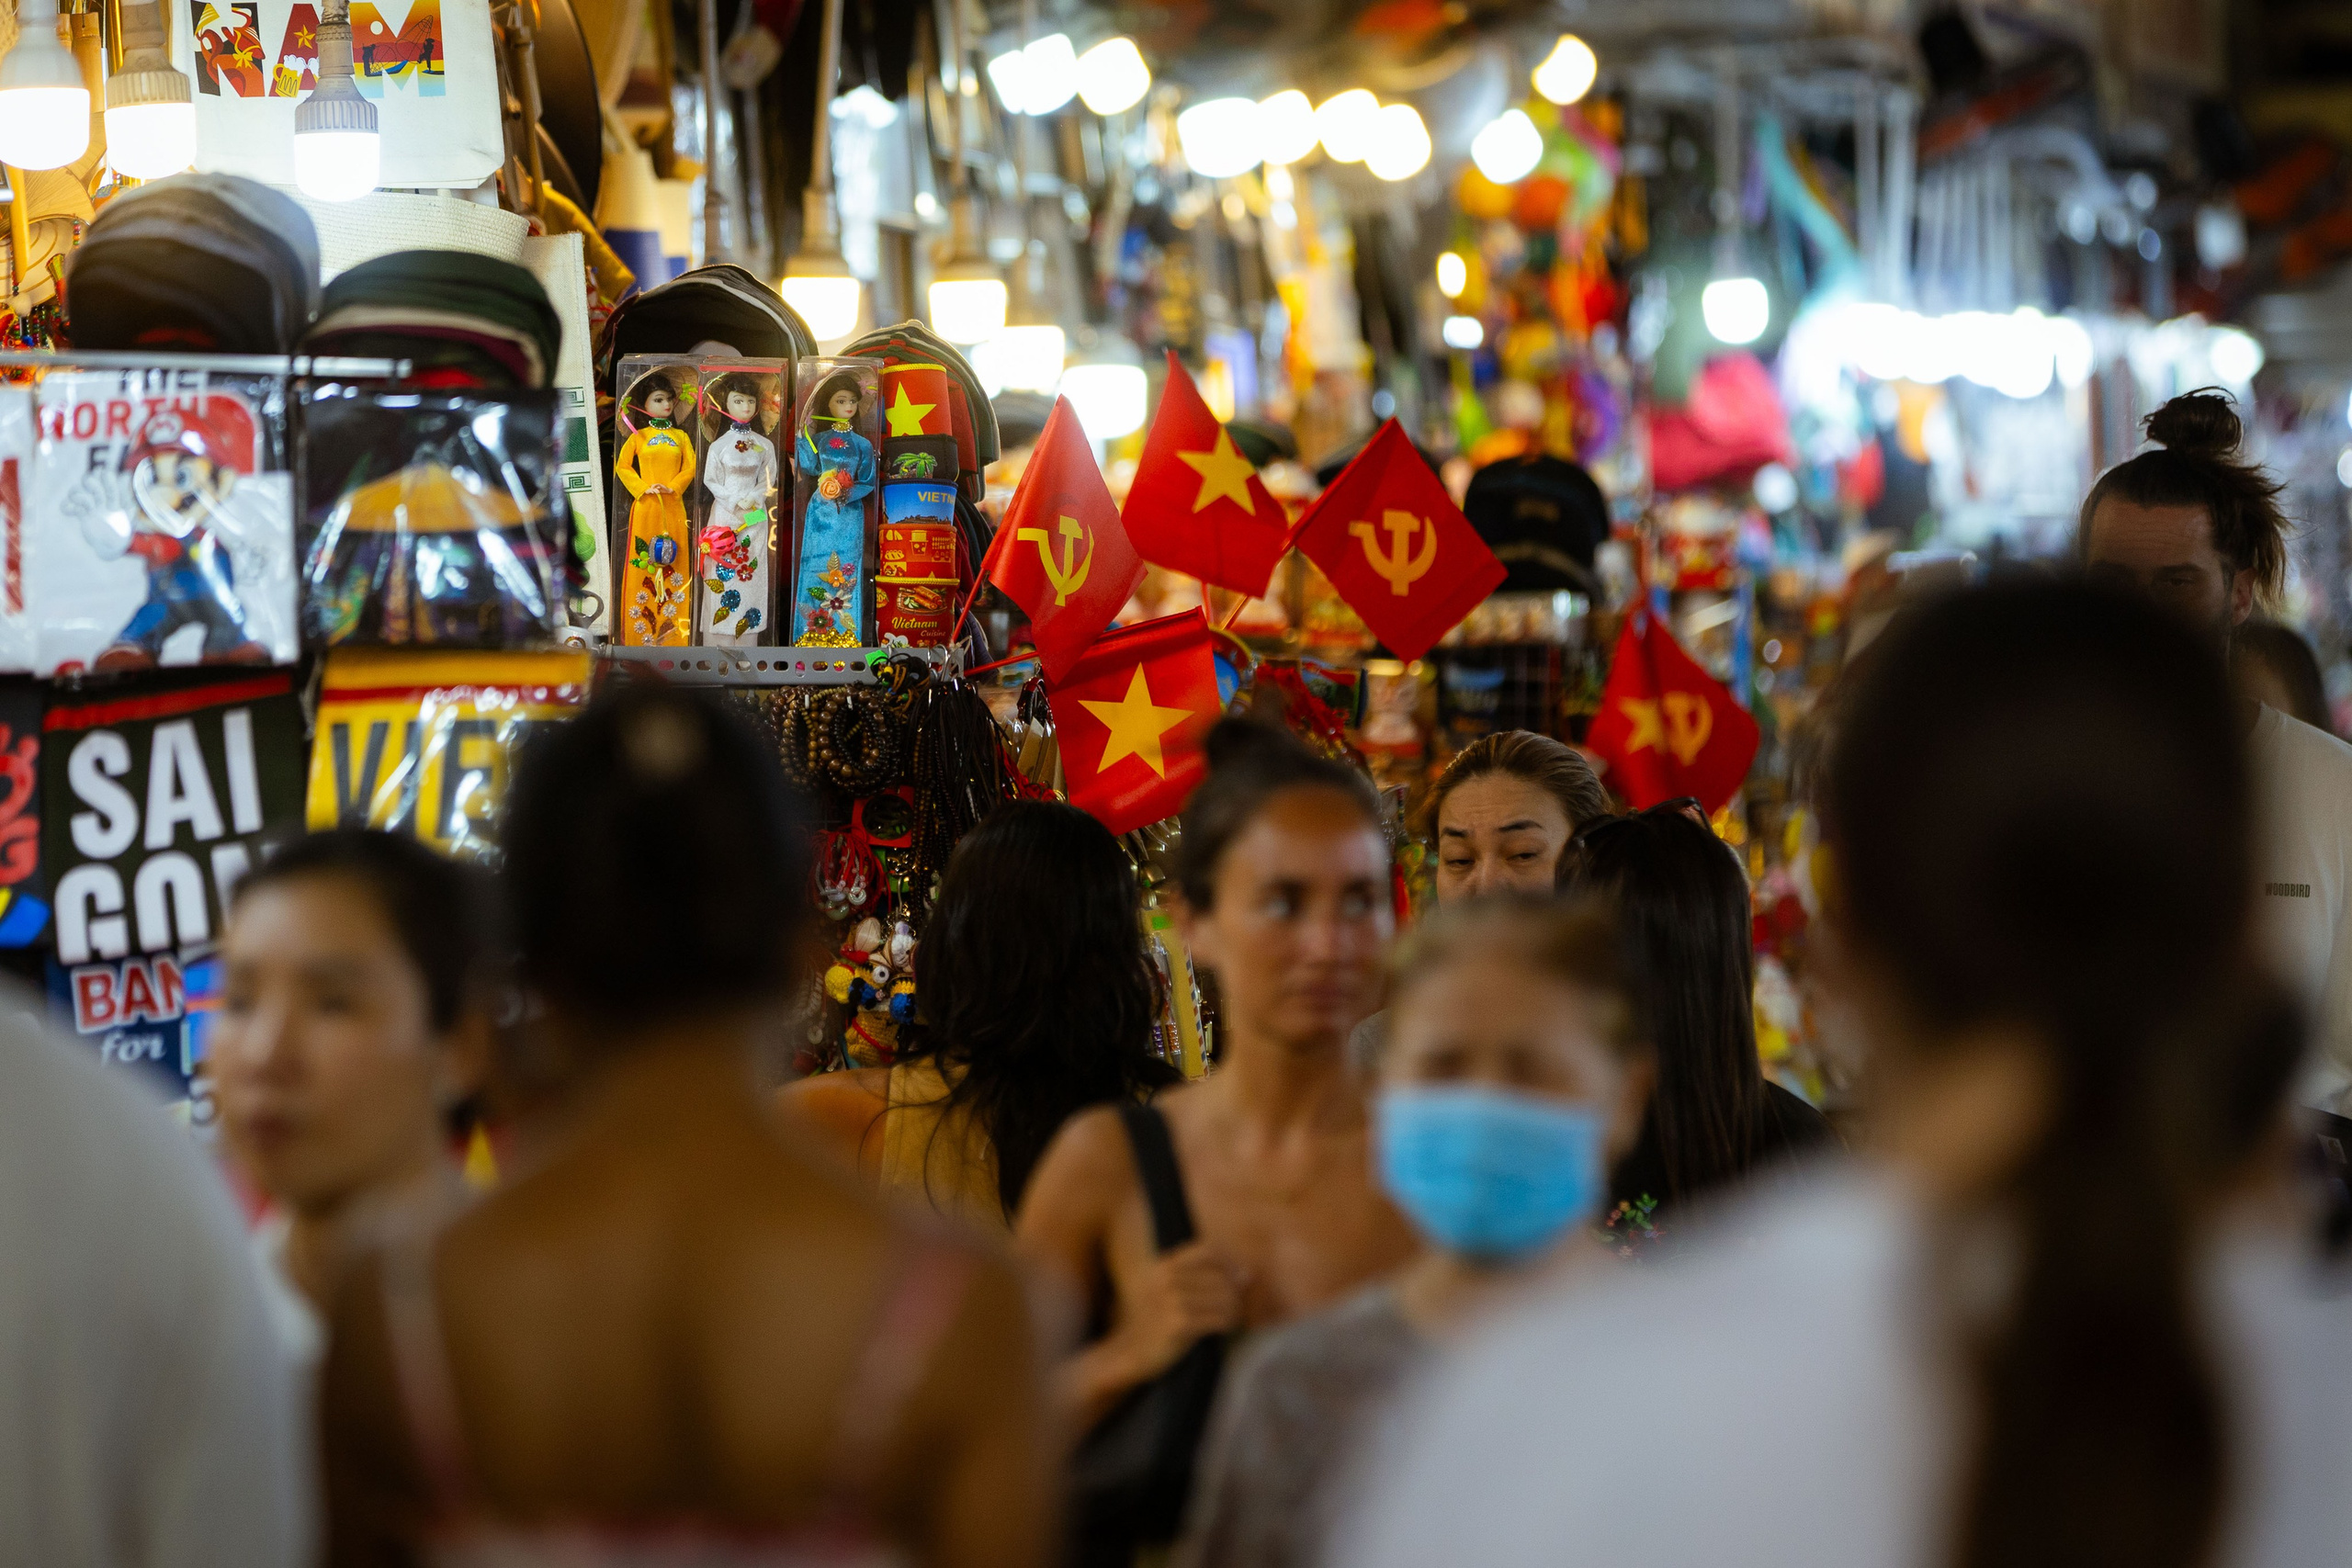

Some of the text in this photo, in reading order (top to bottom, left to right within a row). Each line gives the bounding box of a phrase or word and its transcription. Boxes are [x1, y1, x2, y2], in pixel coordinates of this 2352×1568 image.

[190, 1, 447, 98] NAM
[891, 616, 938, 629] Vietnam
[921, 629, 946, 637] Cuisine
[67, 706, 265, 861] SAI
[331, 719, 514, 838] VIE
[2265, 883, 2311, 897] WOODBIRD
[101, 1031, 166, 1066] for
